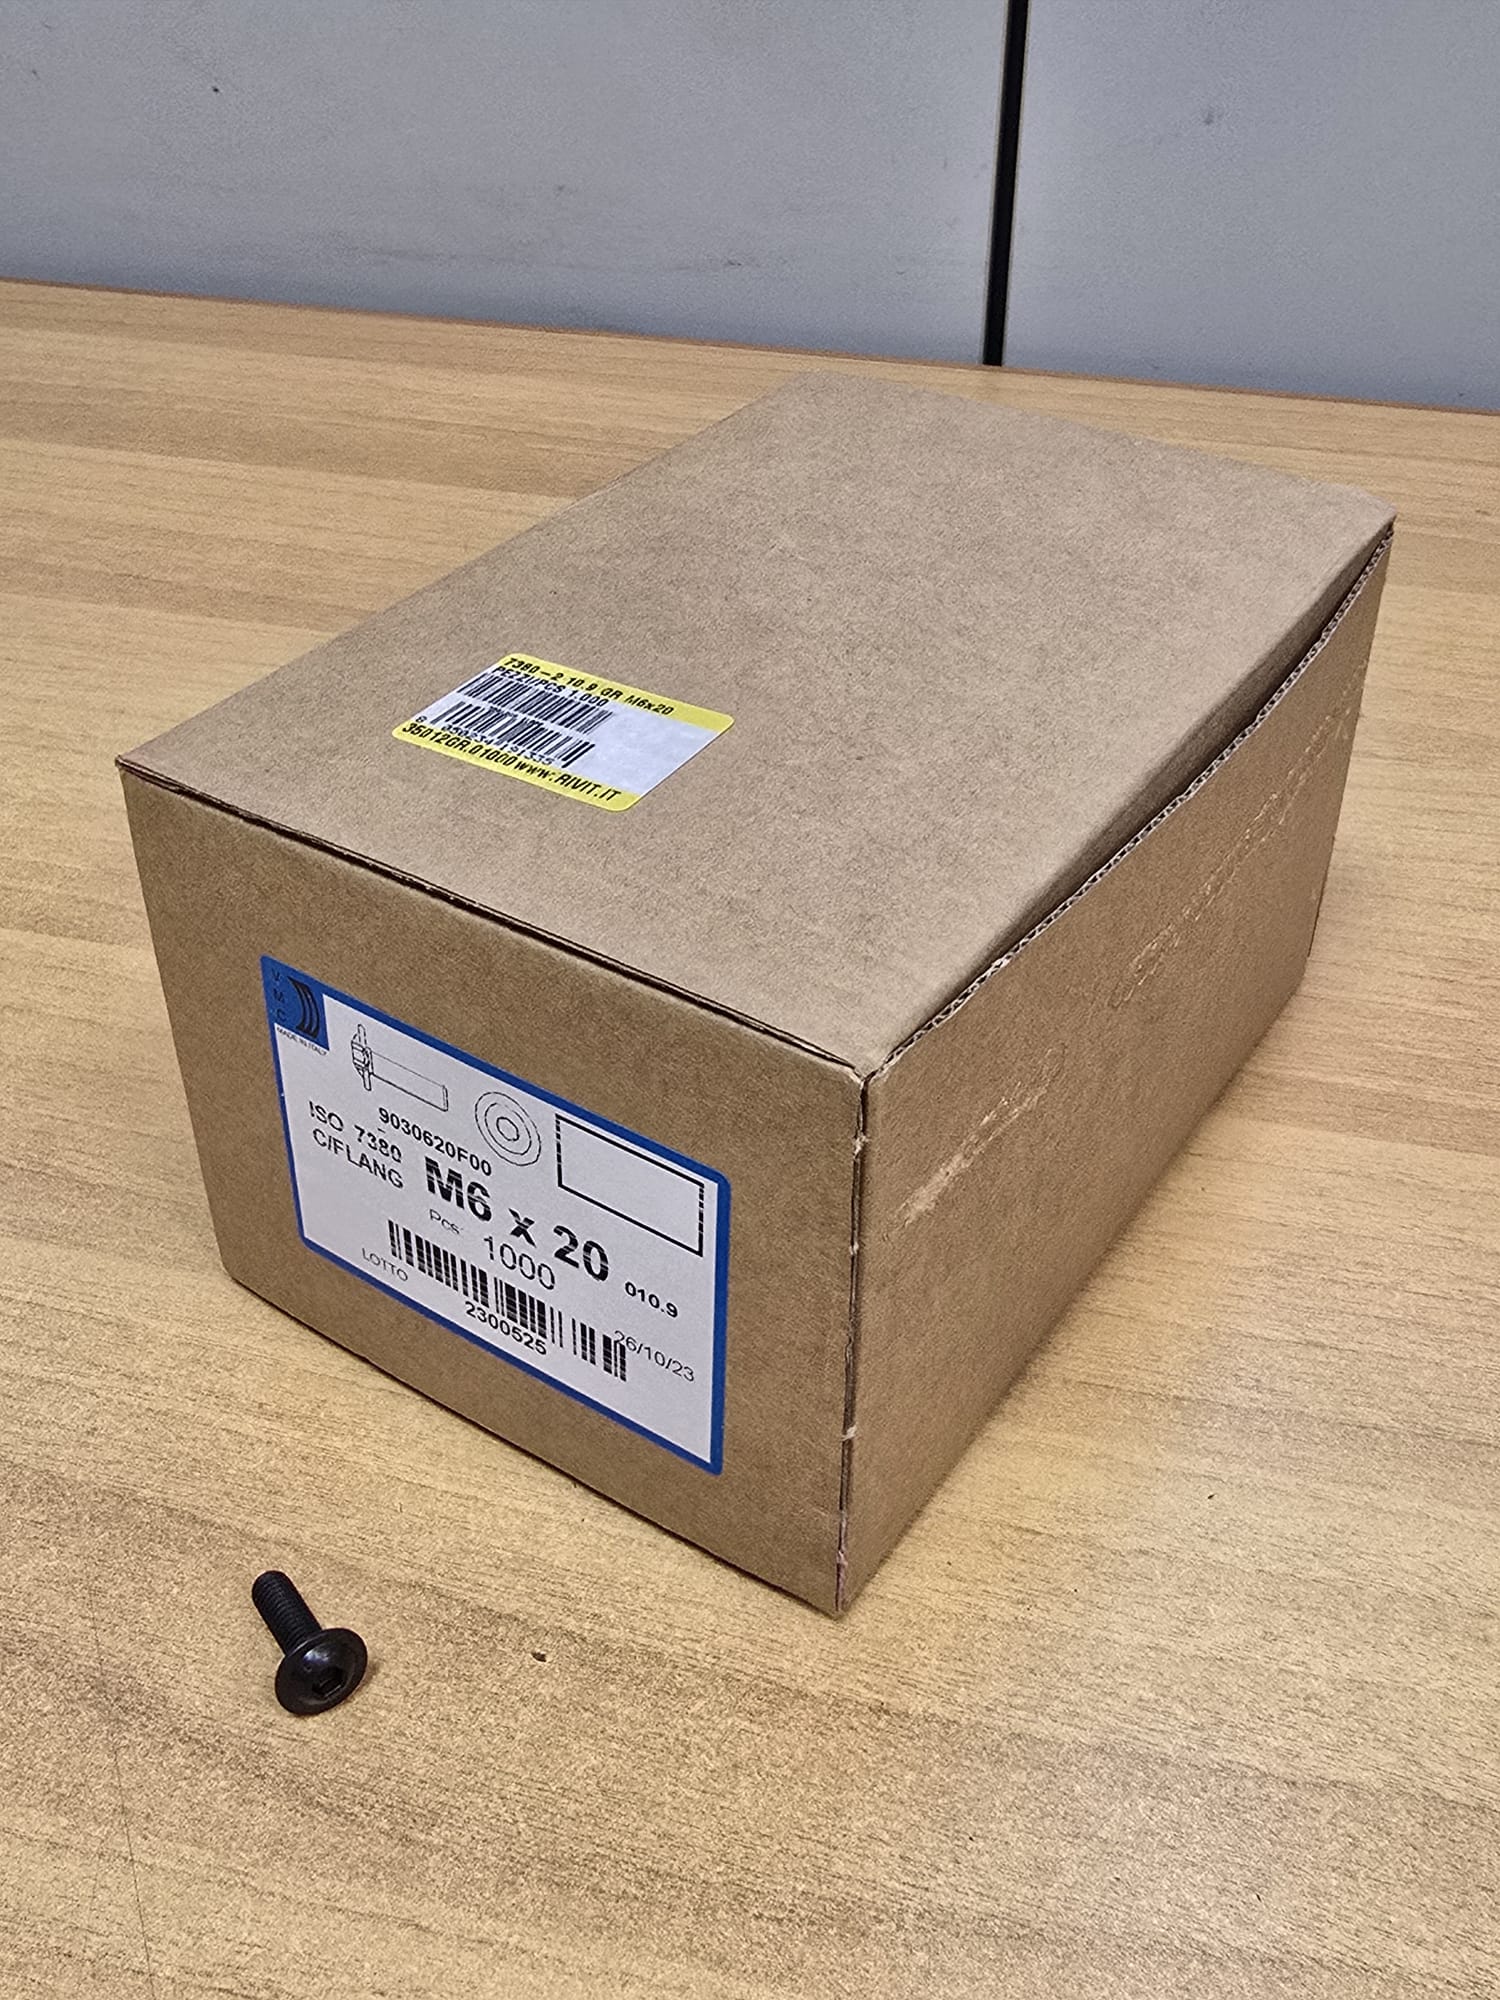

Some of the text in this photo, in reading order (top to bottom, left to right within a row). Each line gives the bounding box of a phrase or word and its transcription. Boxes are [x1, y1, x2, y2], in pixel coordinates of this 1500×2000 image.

[492, 665, 609, 707] PEZZI/PCS 1.000
[566, 677, 598, 691] 10.9
[600, 687, 623, 699] GR
[624, 695, 675, 715] M6x20
[309, 1101, 402, 1163] ISO 7380
[378, 1107, 492, 1176] 9030620F00
[425, 1156, 492, 1222] M6
[553, 1225, 610, 1282] 20
[361, 1247, 409, 1282] LOTTO
[483, 1236, 556, 1290] 1000
[624, 1281, 679, 1318] 010.9
[464, 1300, 548, 1356] 2300525
[613, 1330, 696, 1383] 26/10/23
